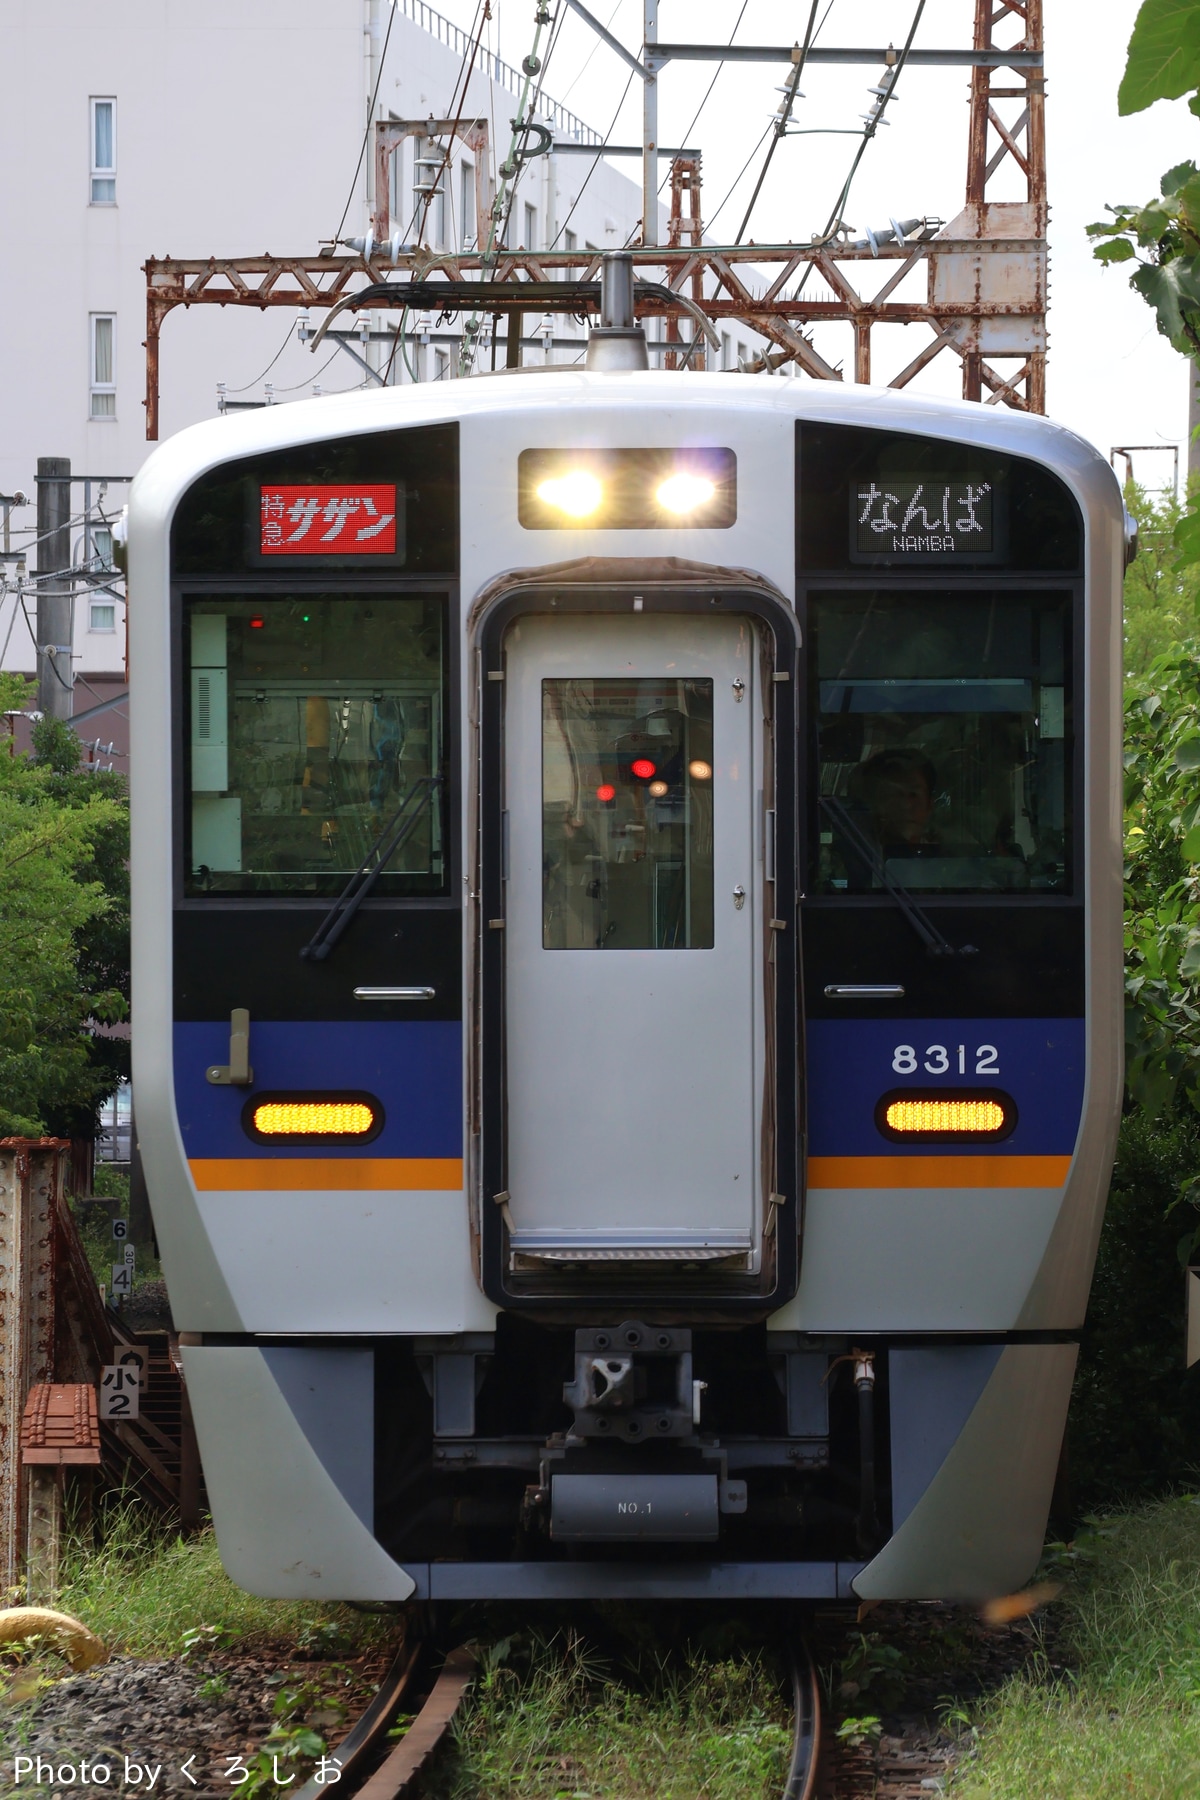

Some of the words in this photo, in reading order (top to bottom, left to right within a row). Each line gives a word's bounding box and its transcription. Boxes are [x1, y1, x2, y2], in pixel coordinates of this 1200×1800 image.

[858, 483, 991, 532] なんば
[286, 498, 395, 542] サザン
[893, 536, 954, 551] NAMBA
[892, 1044, 999, 1074] 8312
[114, 1222, 126, 1237] 6
[114, 1269, 130, 1289] 4
[618, 1502, 652, 1514] NO.1
